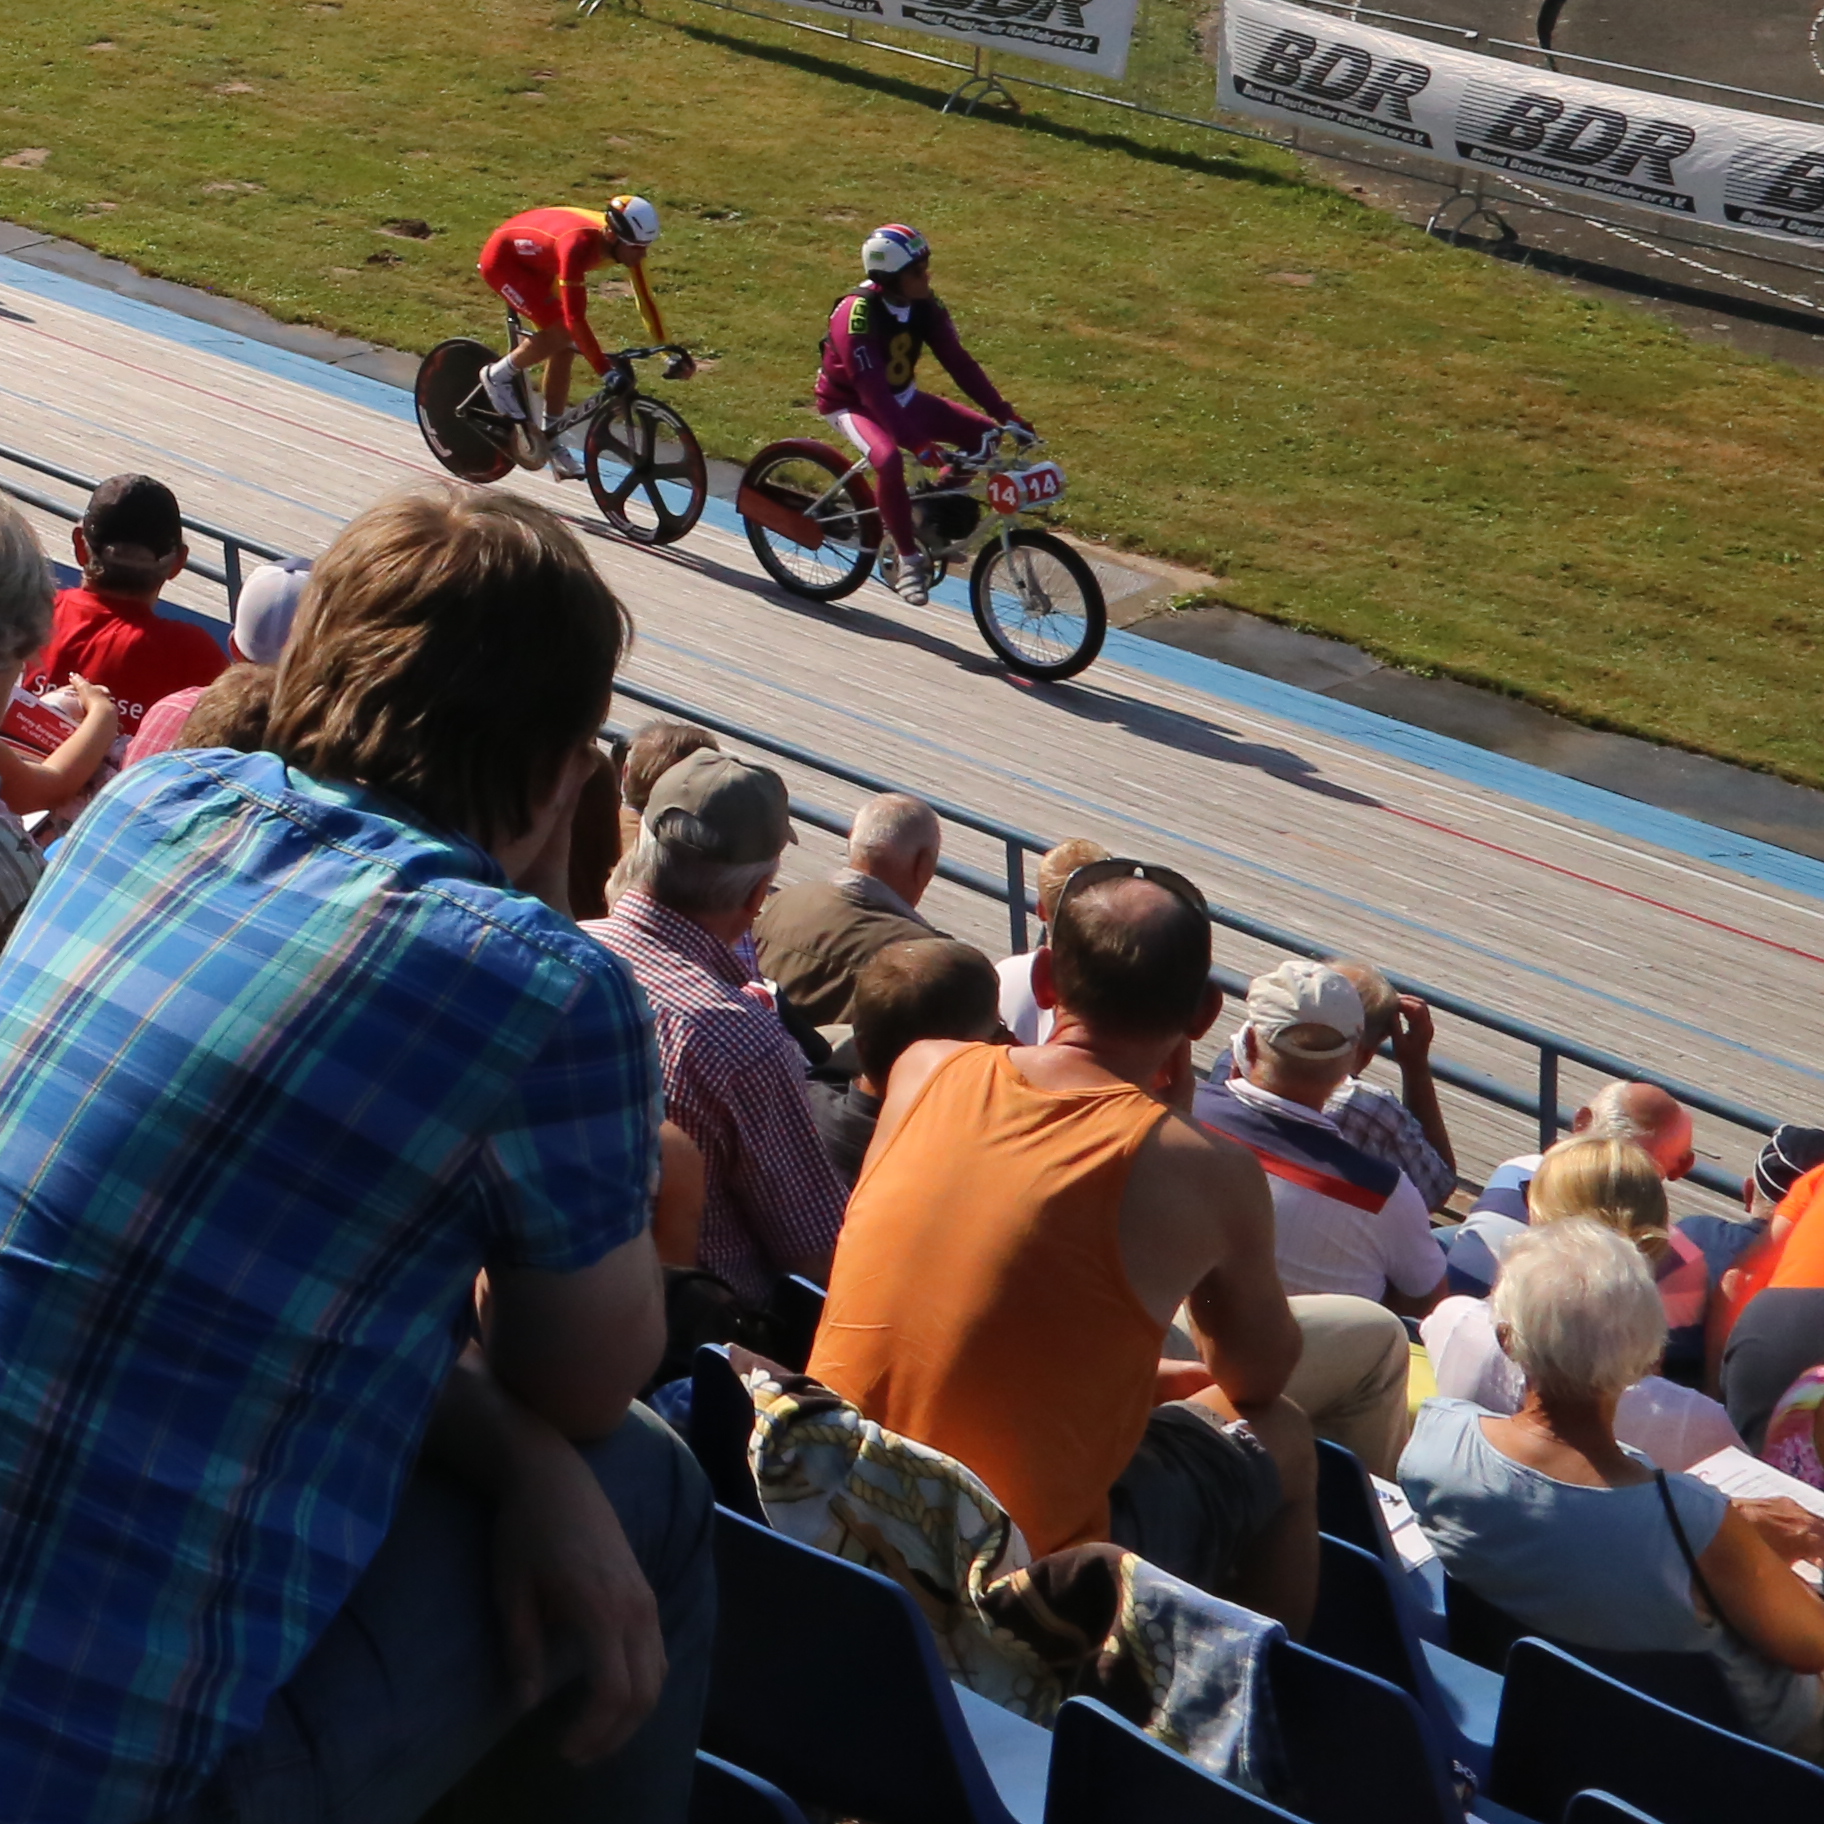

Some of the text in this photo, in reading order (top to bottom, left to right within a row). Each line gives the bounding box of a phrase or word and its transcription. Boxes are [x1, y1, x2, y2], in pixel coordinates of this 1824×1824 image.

[1251, 28, 1431, 123] BDR
[1242, 83, 1273, 101] Bund
[1274, 93, 1337, 120] Deutscher
[1337, 111, 1402, 139] Radfahrer
[1482, 92, 1697, 186] BDR
[1469, 148, 1507, 168] Bund
[1508, 157, 1584, 186] Deutscher
[1584, 176, 1659, 204] Radfahrer
[1739, 210, 1785, 228] Bund
[886, 333, 912, 386] 8
[988, 482, 1017, 507] 14
[1030, 474, 1057, 500] 14
